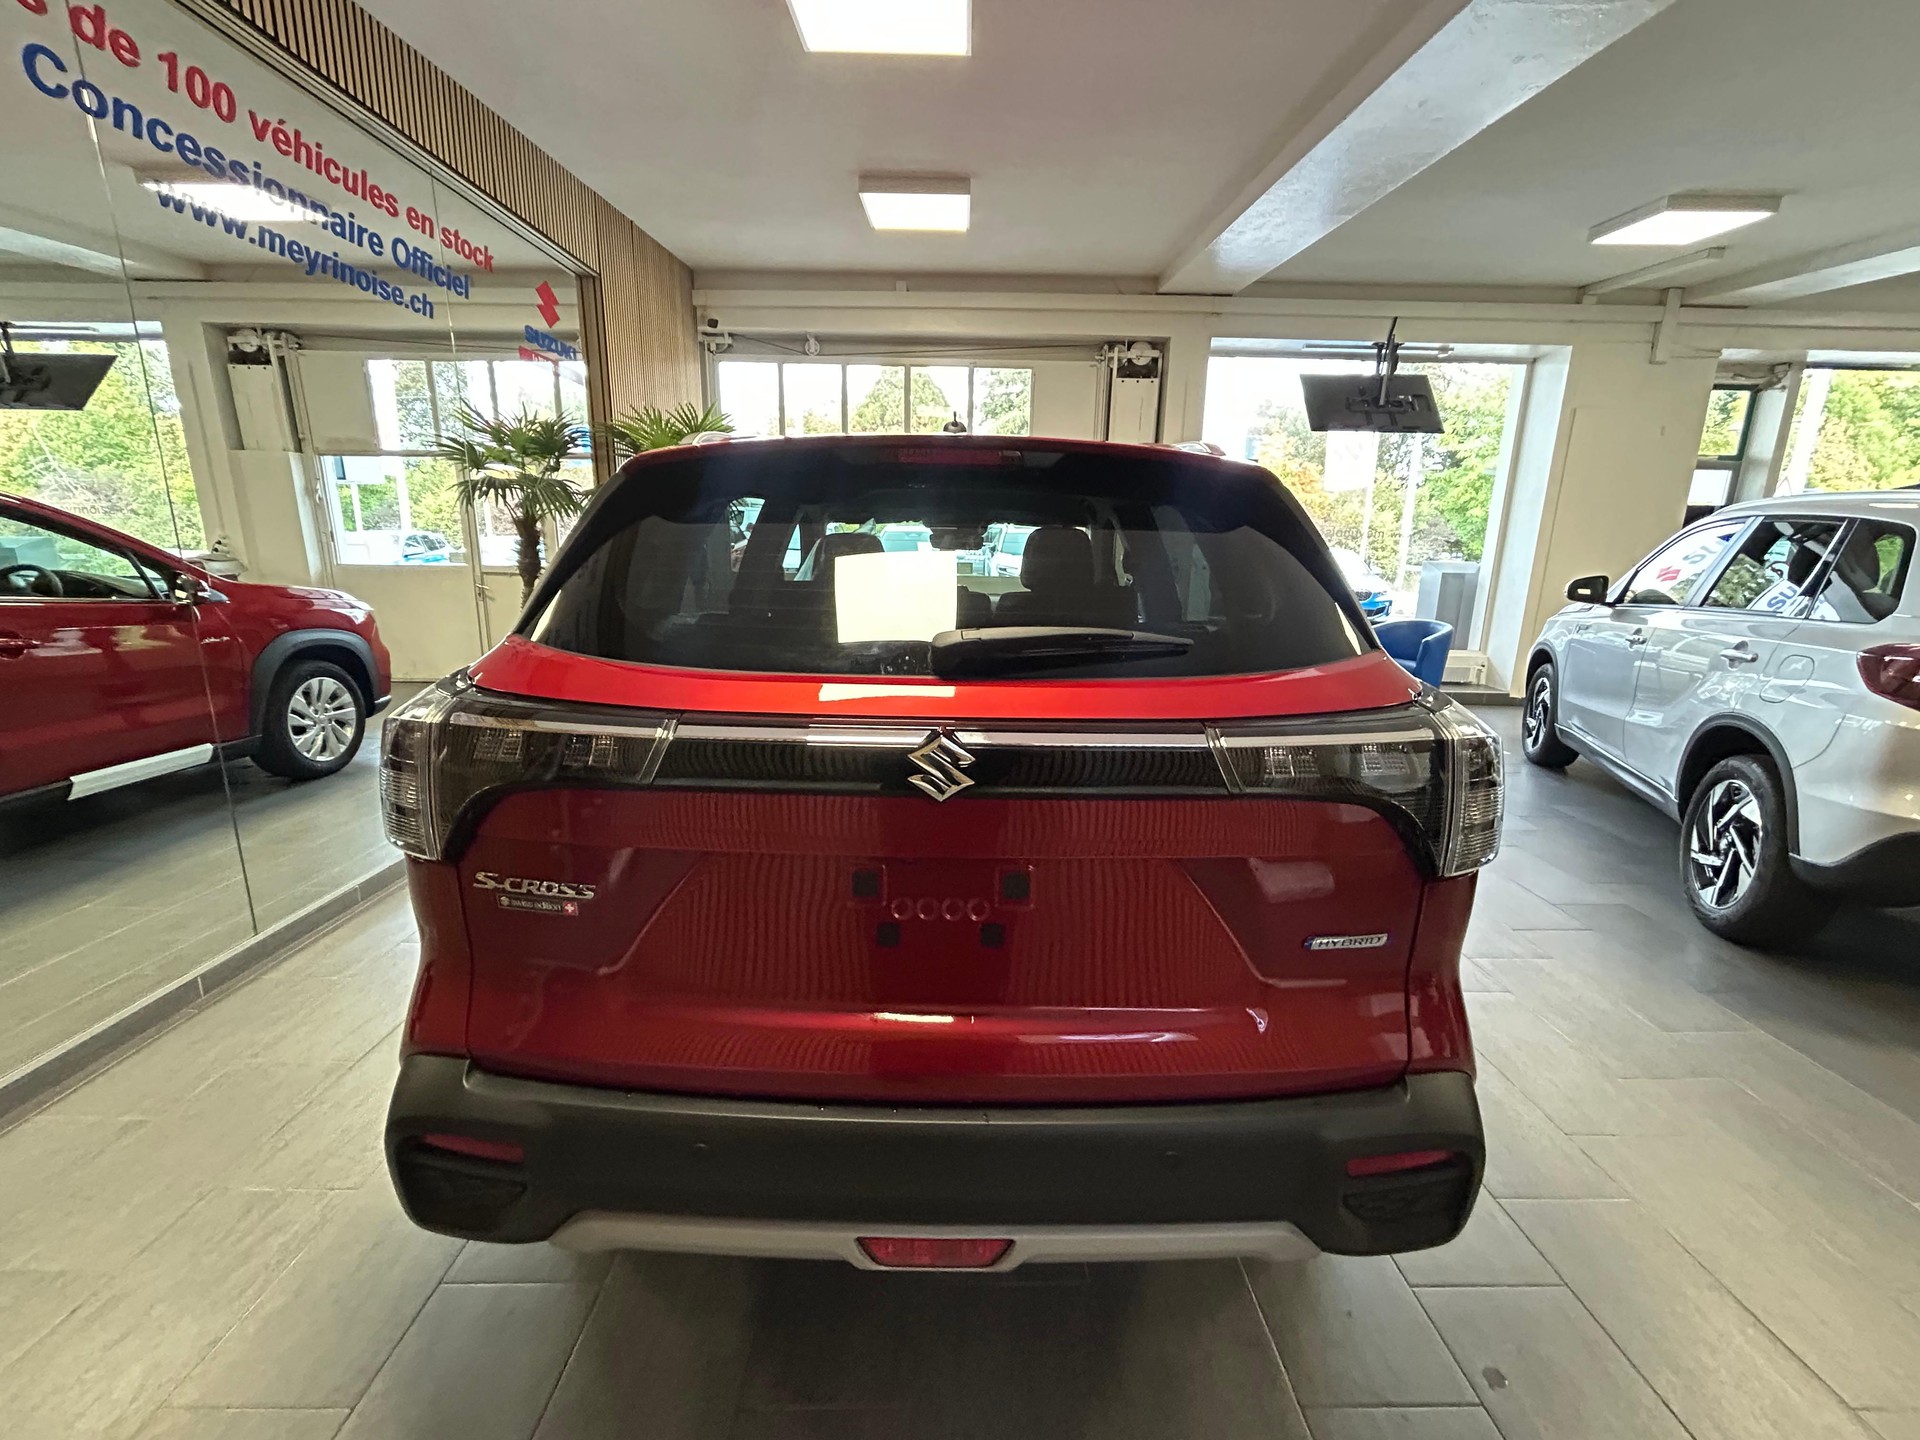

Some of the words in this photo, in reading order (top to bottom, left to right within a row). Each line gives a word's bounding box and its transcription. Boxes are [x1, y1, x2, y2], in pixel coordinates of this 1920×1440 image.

[21, 42, 384, 257] Concessionnaire
[391, 236, 470, 300] Officiel
[69, 4, 142, 68] de
[157, 51, 237, 123] 100
[248, 109, 400, 218] véhicules
[405, 206, 435, 239] en
[440, 226, 495, 273] stock
[154, 181, 435, 320] www.meyrinoise.ch
[473, 871, 596, 899] S-CROSS
[1318, 935, 1384, 948] HYBRID
